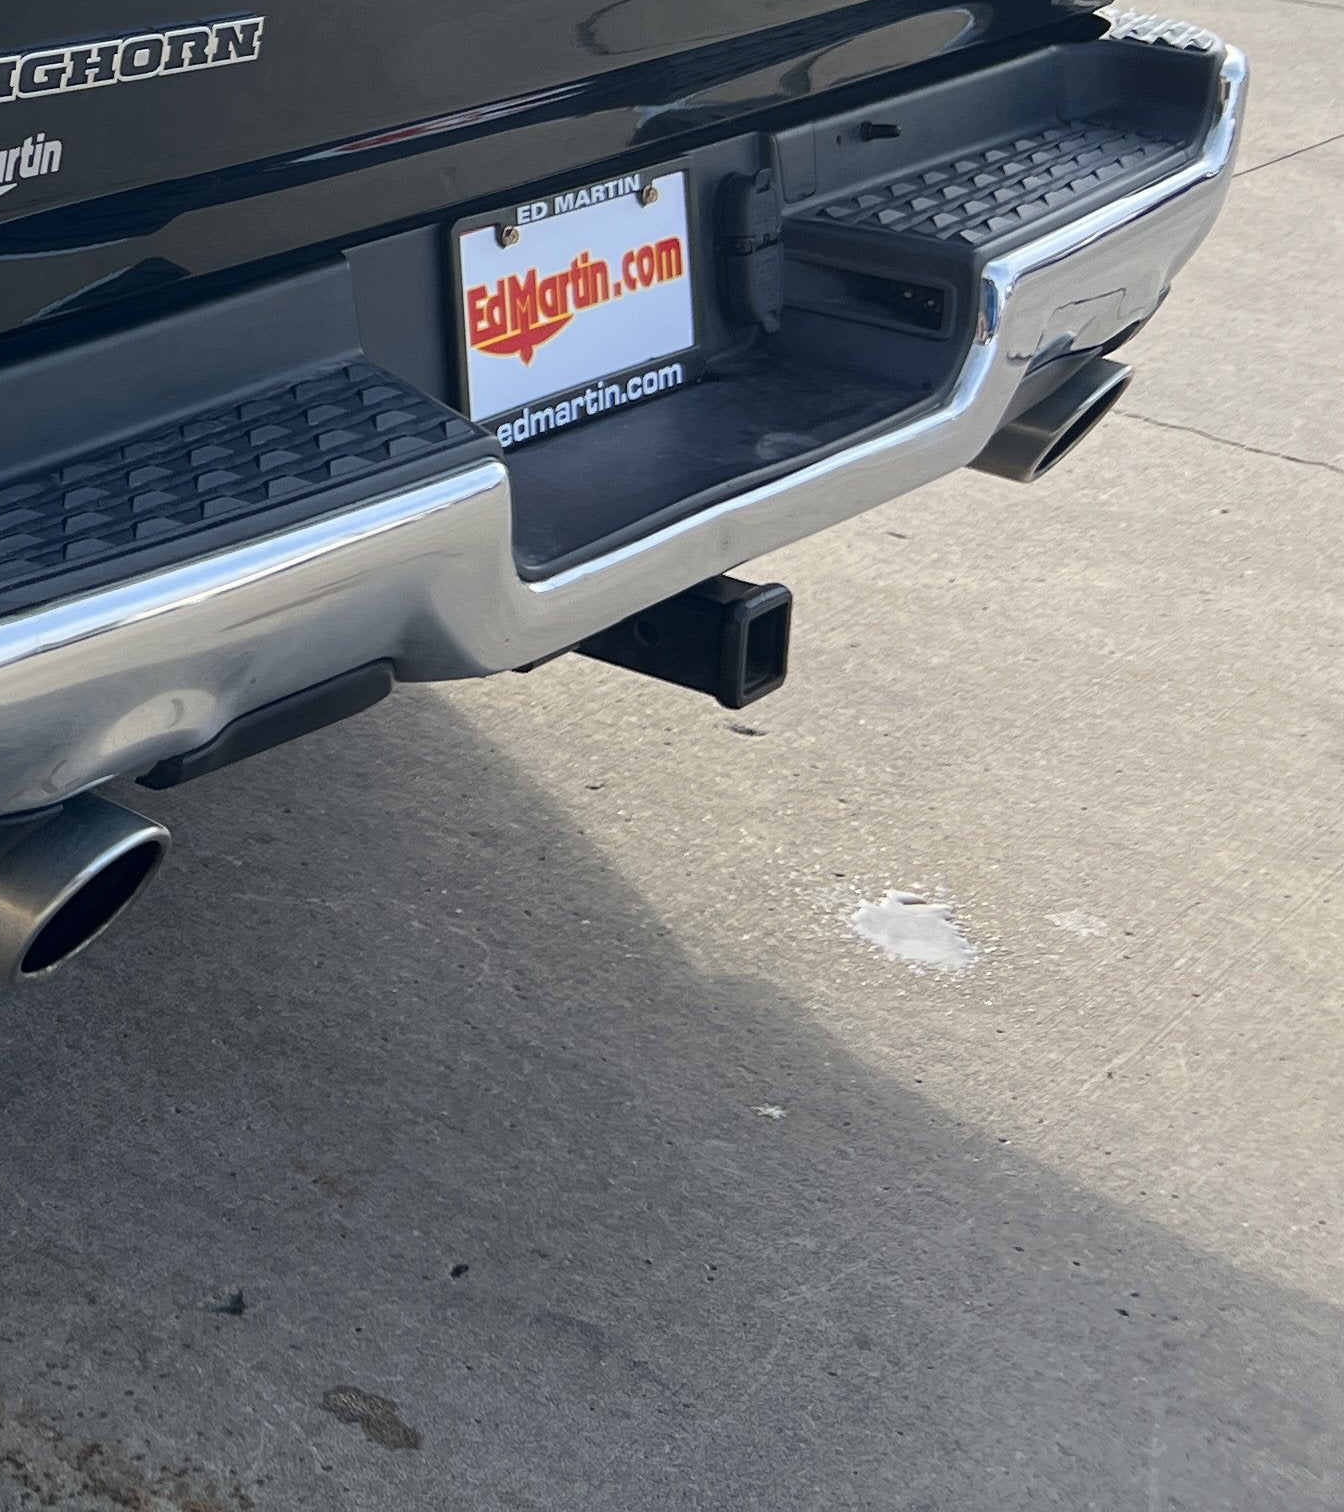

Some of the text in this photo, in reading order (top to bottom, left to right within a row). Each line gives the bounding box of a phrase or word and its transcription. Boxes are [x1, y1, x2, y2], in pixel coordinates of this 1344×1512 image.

[516, 174, 642, 225] ED MARTIN
[496, 363, 685, 448] edmartin.com
